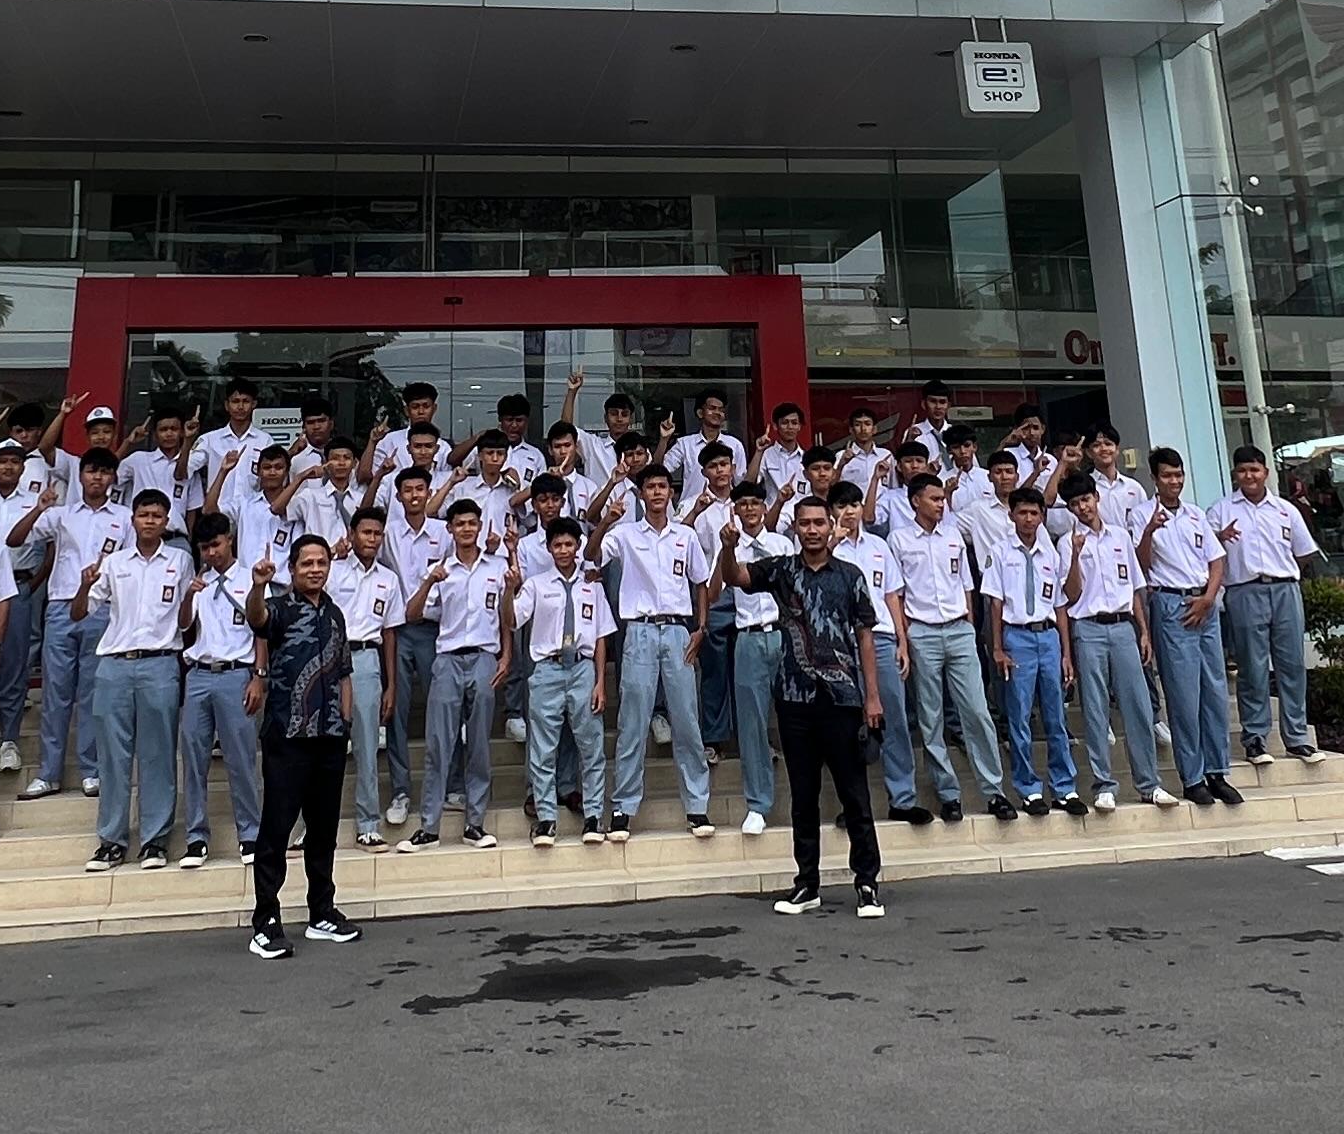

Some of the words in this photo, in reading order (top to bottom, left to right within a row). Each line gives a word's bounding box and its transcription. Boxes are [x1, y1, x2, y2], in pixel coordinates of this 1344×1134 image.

[973, 51, 1021, 60] HONDA
[983, 90, 1023, 102] SHOP
[1064, 329, 1104, 365] On
